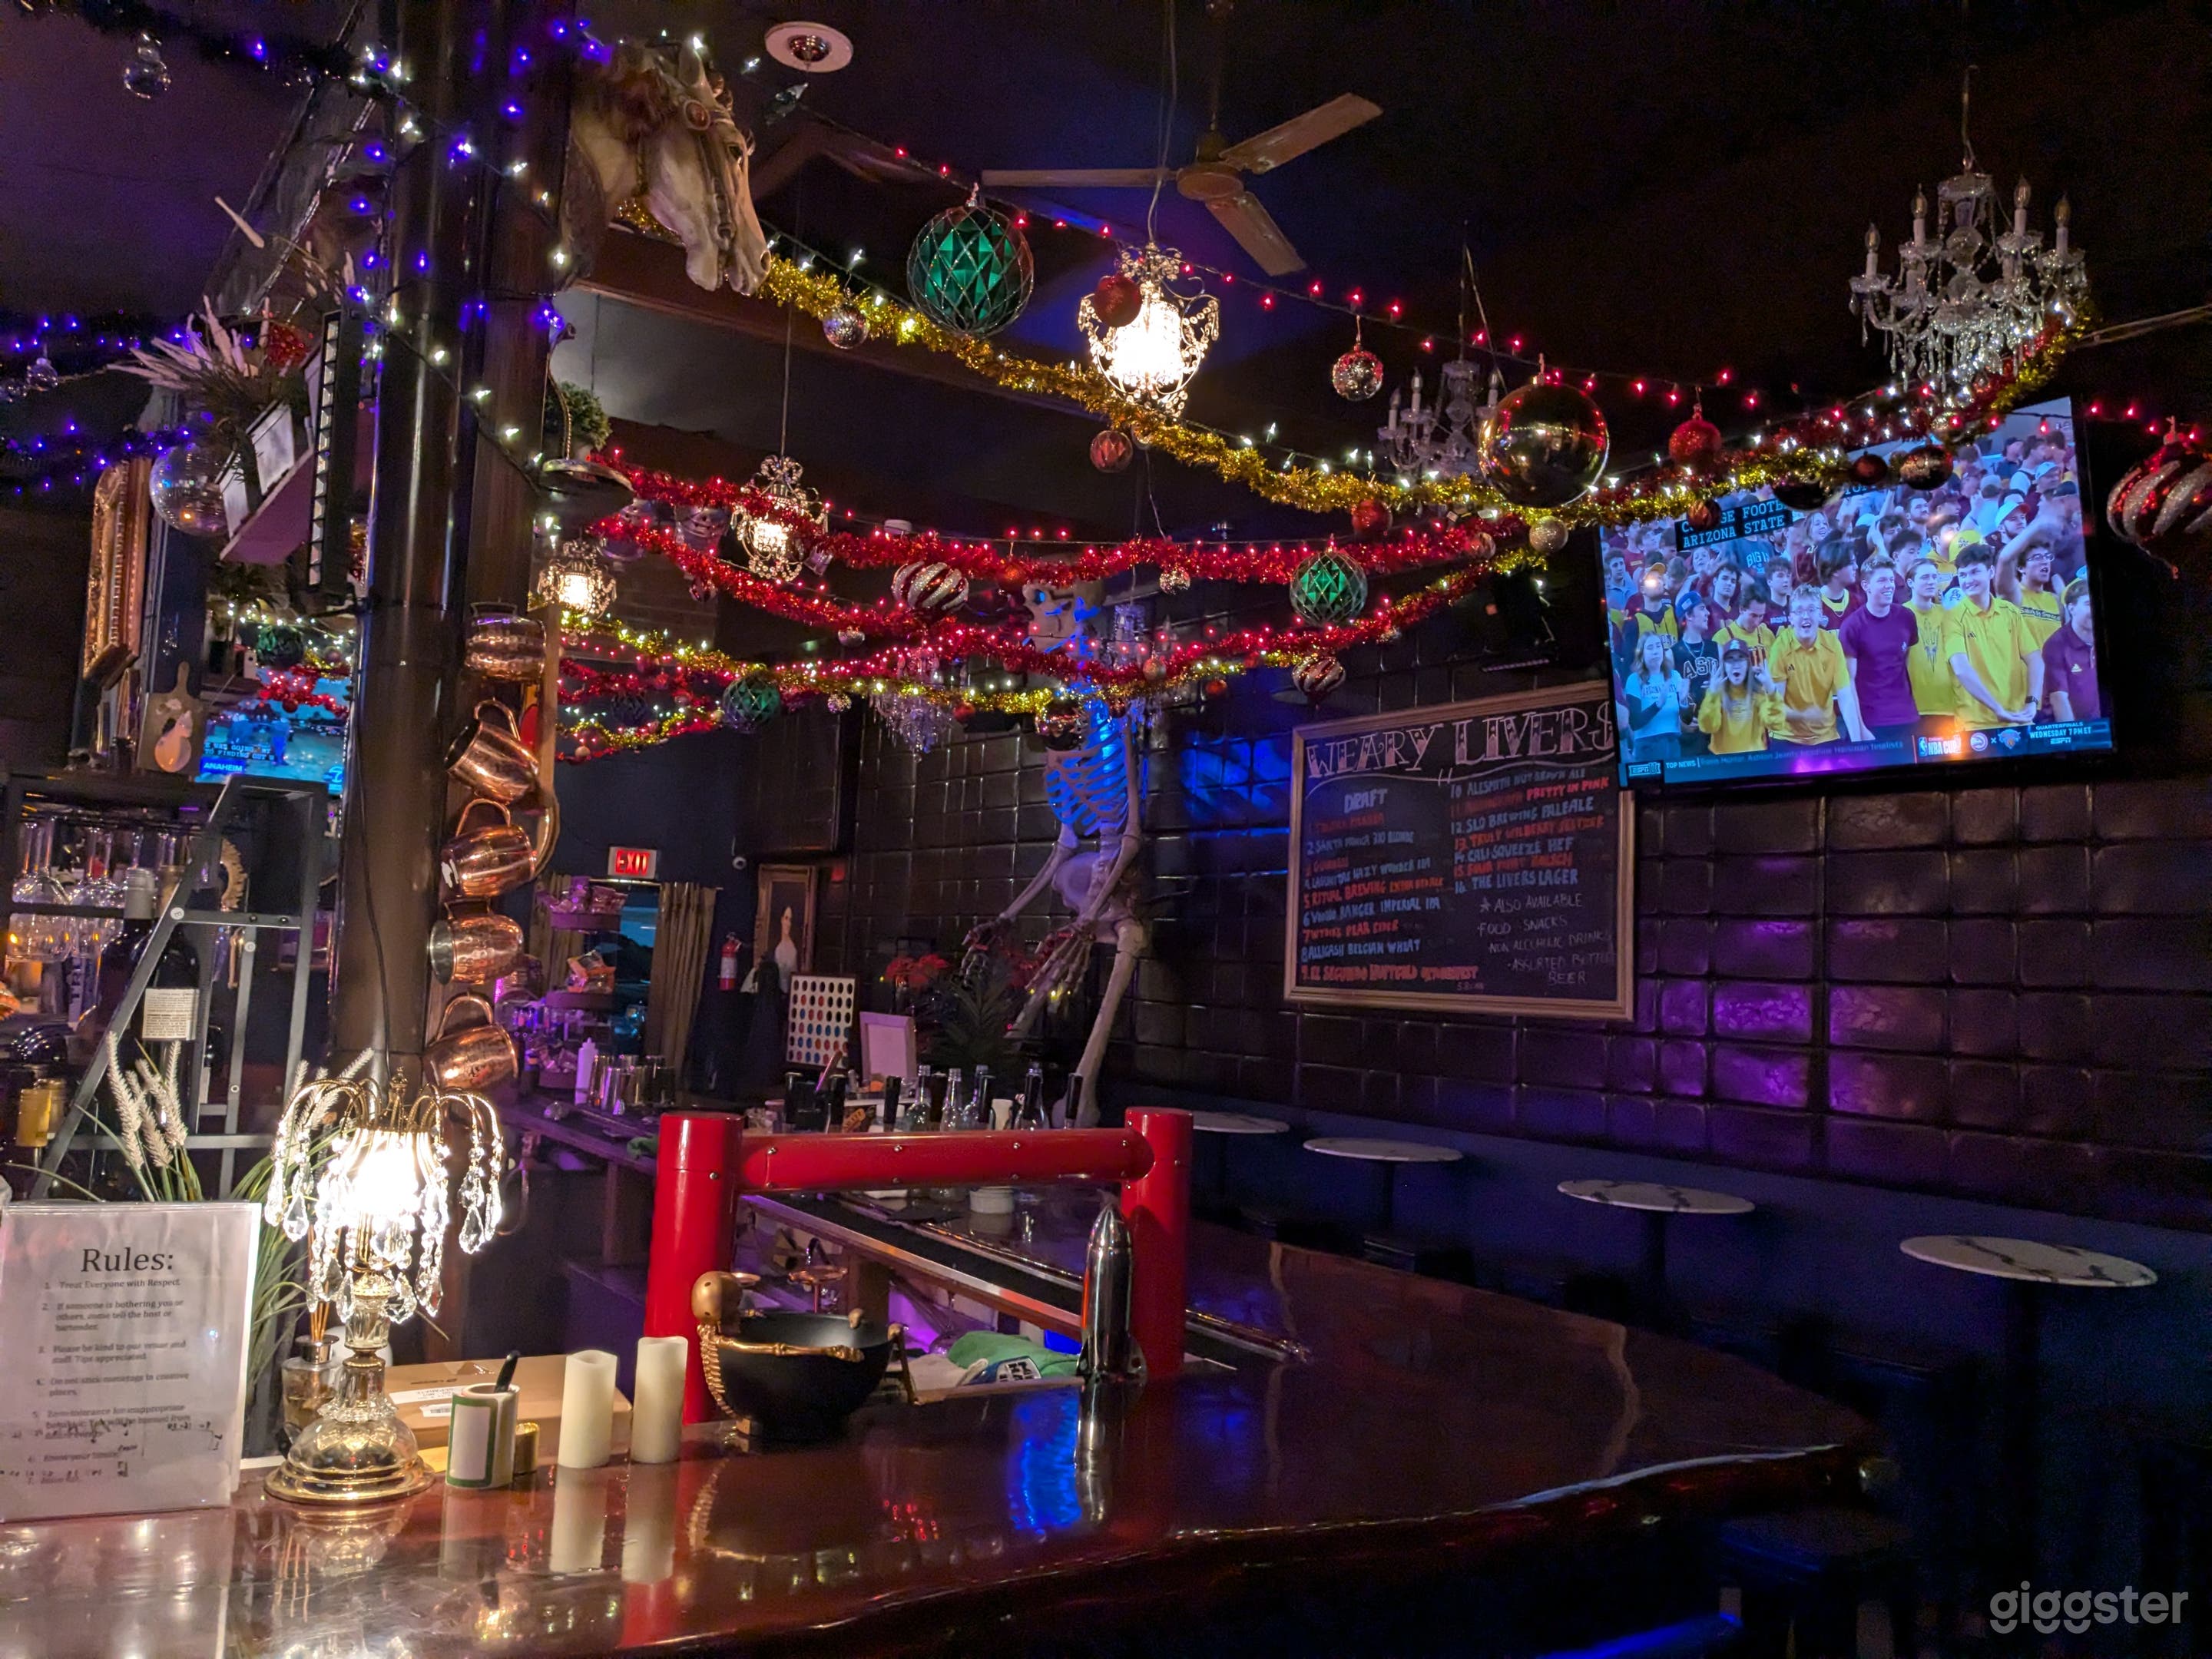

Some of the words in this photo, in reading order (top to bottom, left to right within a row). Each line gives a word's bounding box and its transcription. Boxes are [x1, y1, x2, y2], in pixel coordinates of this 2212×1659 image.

[1684, 526, 1736, 548] ARIZONA
[1744, 515, 1785, 534] STATE
[1306, 724, 1444, 778] WEARY
[1452, 701, 1614, 765] LIVERS
[2029, 729, 2066, 739] WEDNESDAY
[1928, 742, 1942, 755] NBA
[204, 763, 242, 772] ANAHEIM
[1526, 783, 1565, 801] PRETTY
[1567, 782, 1579, 793] IN
[1582, 777, 1610, 791] PINK
[1344, 788, 1388, 813] DRAFT
[1466, 817, 1485, 833] SLO
[1488, 808, 1538, 826] BREWING
[1470, 830, 1502, 846] TRULY
[1548, 836, 1574, 853] HEF
[615, 849, 650, 874] EXIT
[1472, 875, 1492, 889] THE
[1498, 869, 1535, 888] LIVERS
[1538, 868, 1578, 886] LAGER
[1345, 881, 1386, 900] BREWING
[1494, 898, 1522, 913] ALSO
[1525, 893, 1584, 908] AVAILABLE
[1524, 915, 1568, 932] SNACKS
[1387, 939, 1420, 953] WHEAT
[1548, 971, 1586, 985] BEER
[81, 1247, 174, 1273] Rules:
[84, 1280, 124, 1290] Everyone
[115, 1300, 156, 1310] bothering
[157, 1300, 173, 1310] you
[82, 1343, 93, 1352] be
[94, 1343, 114, 1351] kind
[170, 1340, 186, 1349] and
